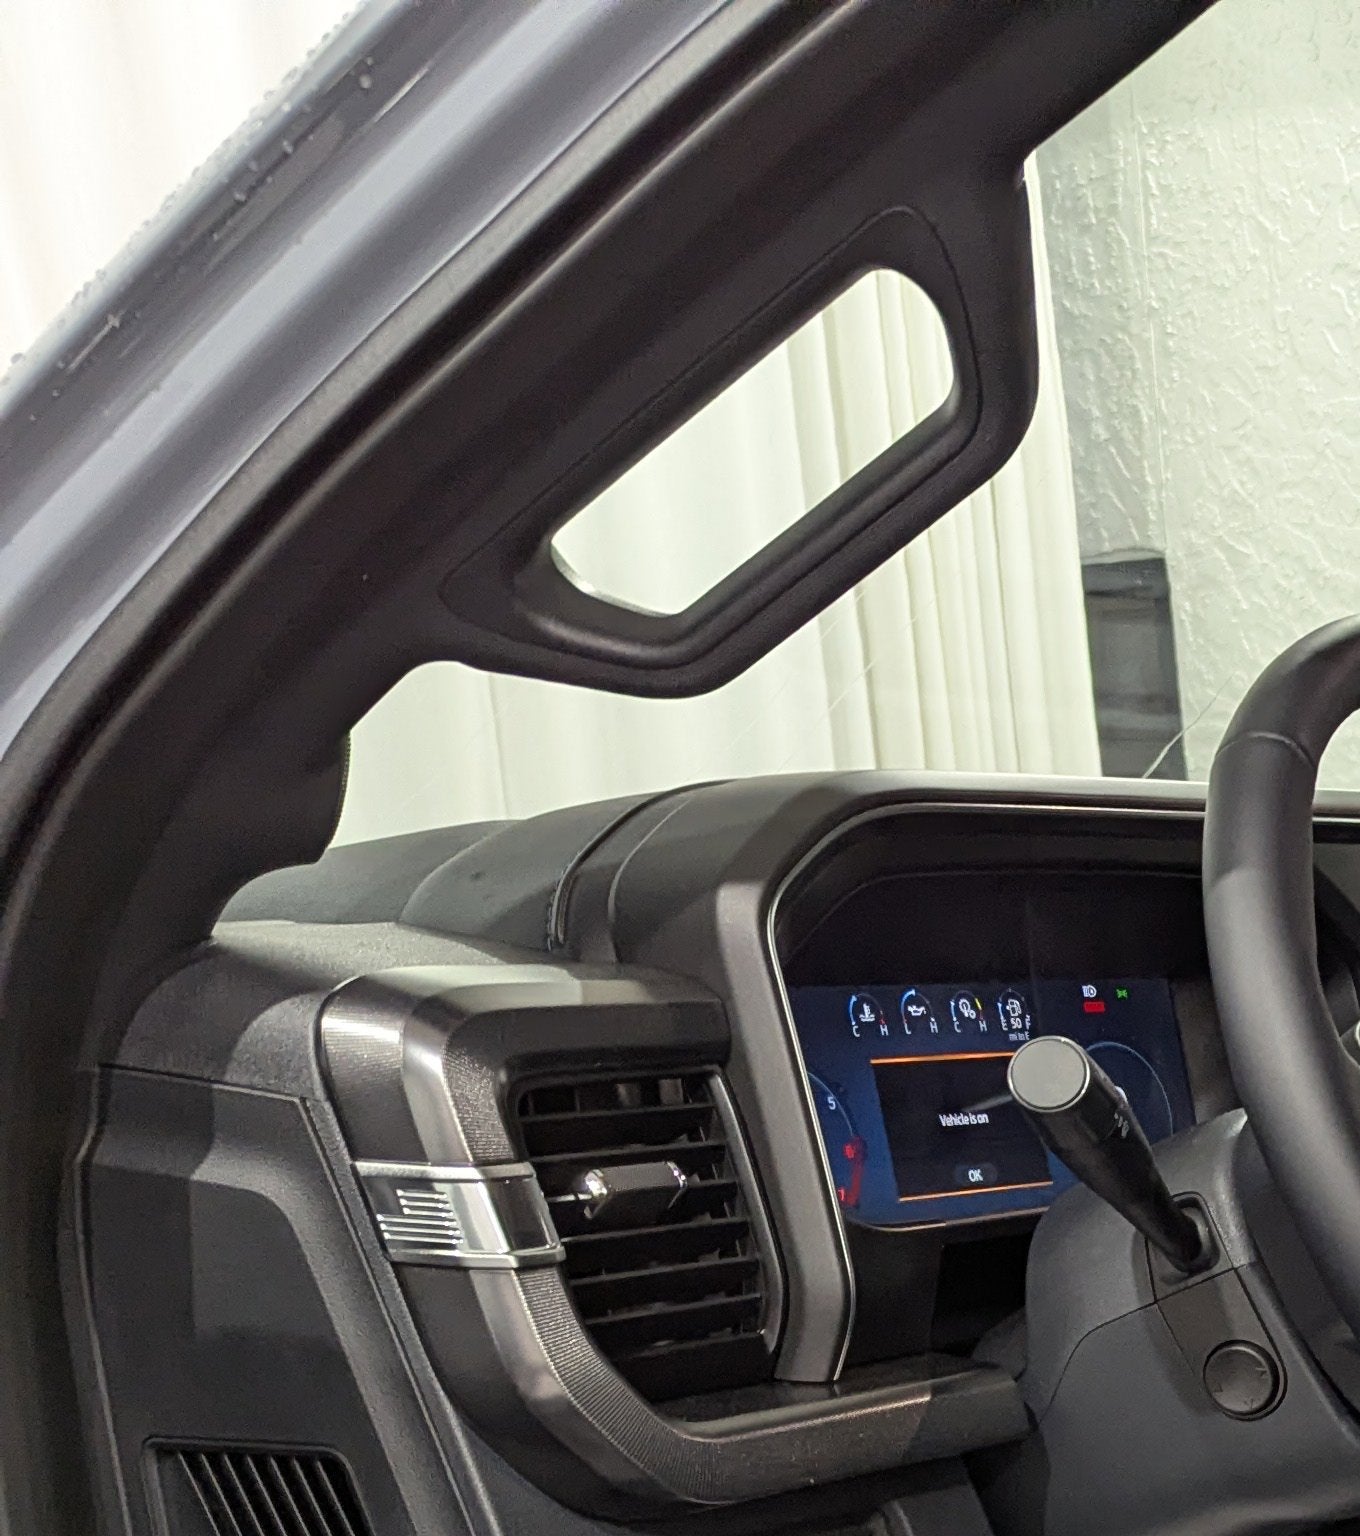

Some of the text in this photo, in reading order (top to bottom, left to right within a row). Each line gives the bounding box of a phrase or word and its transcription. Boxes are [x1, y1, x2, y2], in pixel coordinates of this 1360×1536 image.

[827, 1096, 837, 1110] 5
[938, 1113, 969, 1127] Vehicle
[968, 1168, 983, 1182] OK
